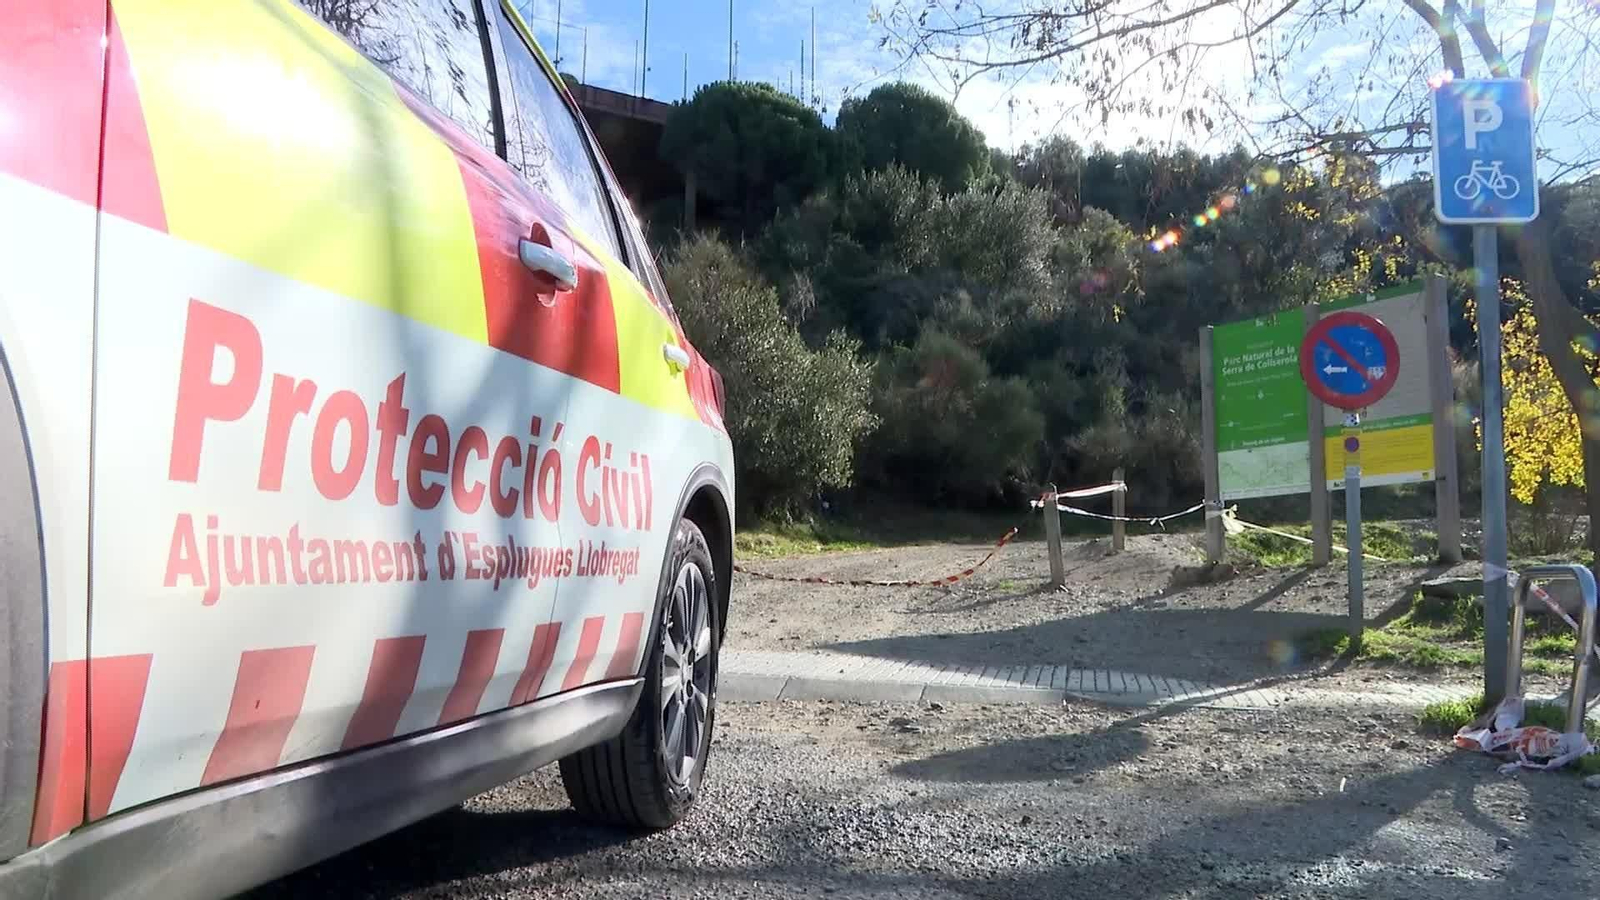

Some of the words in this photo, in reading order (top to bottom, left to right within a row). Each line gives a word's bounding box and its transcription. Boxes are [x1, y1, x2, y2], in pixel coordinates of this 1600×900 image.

[1463, 98, 1504, 150] P
[1222, 366, 1244, 376] Serra
[1245, 362, 1255, 371] de
[1223, 356, 1241, 366] Parc
[1242, 349, 1273, 362] Natural
[1275, 346, 1285, 356] de
[1286, 346, 1295, 355] la
[168, 297, 565, 523] Protecció
[576, 435, 653, 532] Civil
[163, 513, 429, 606] Ajuntament
[576, 539, 641, 585] Llobregat
